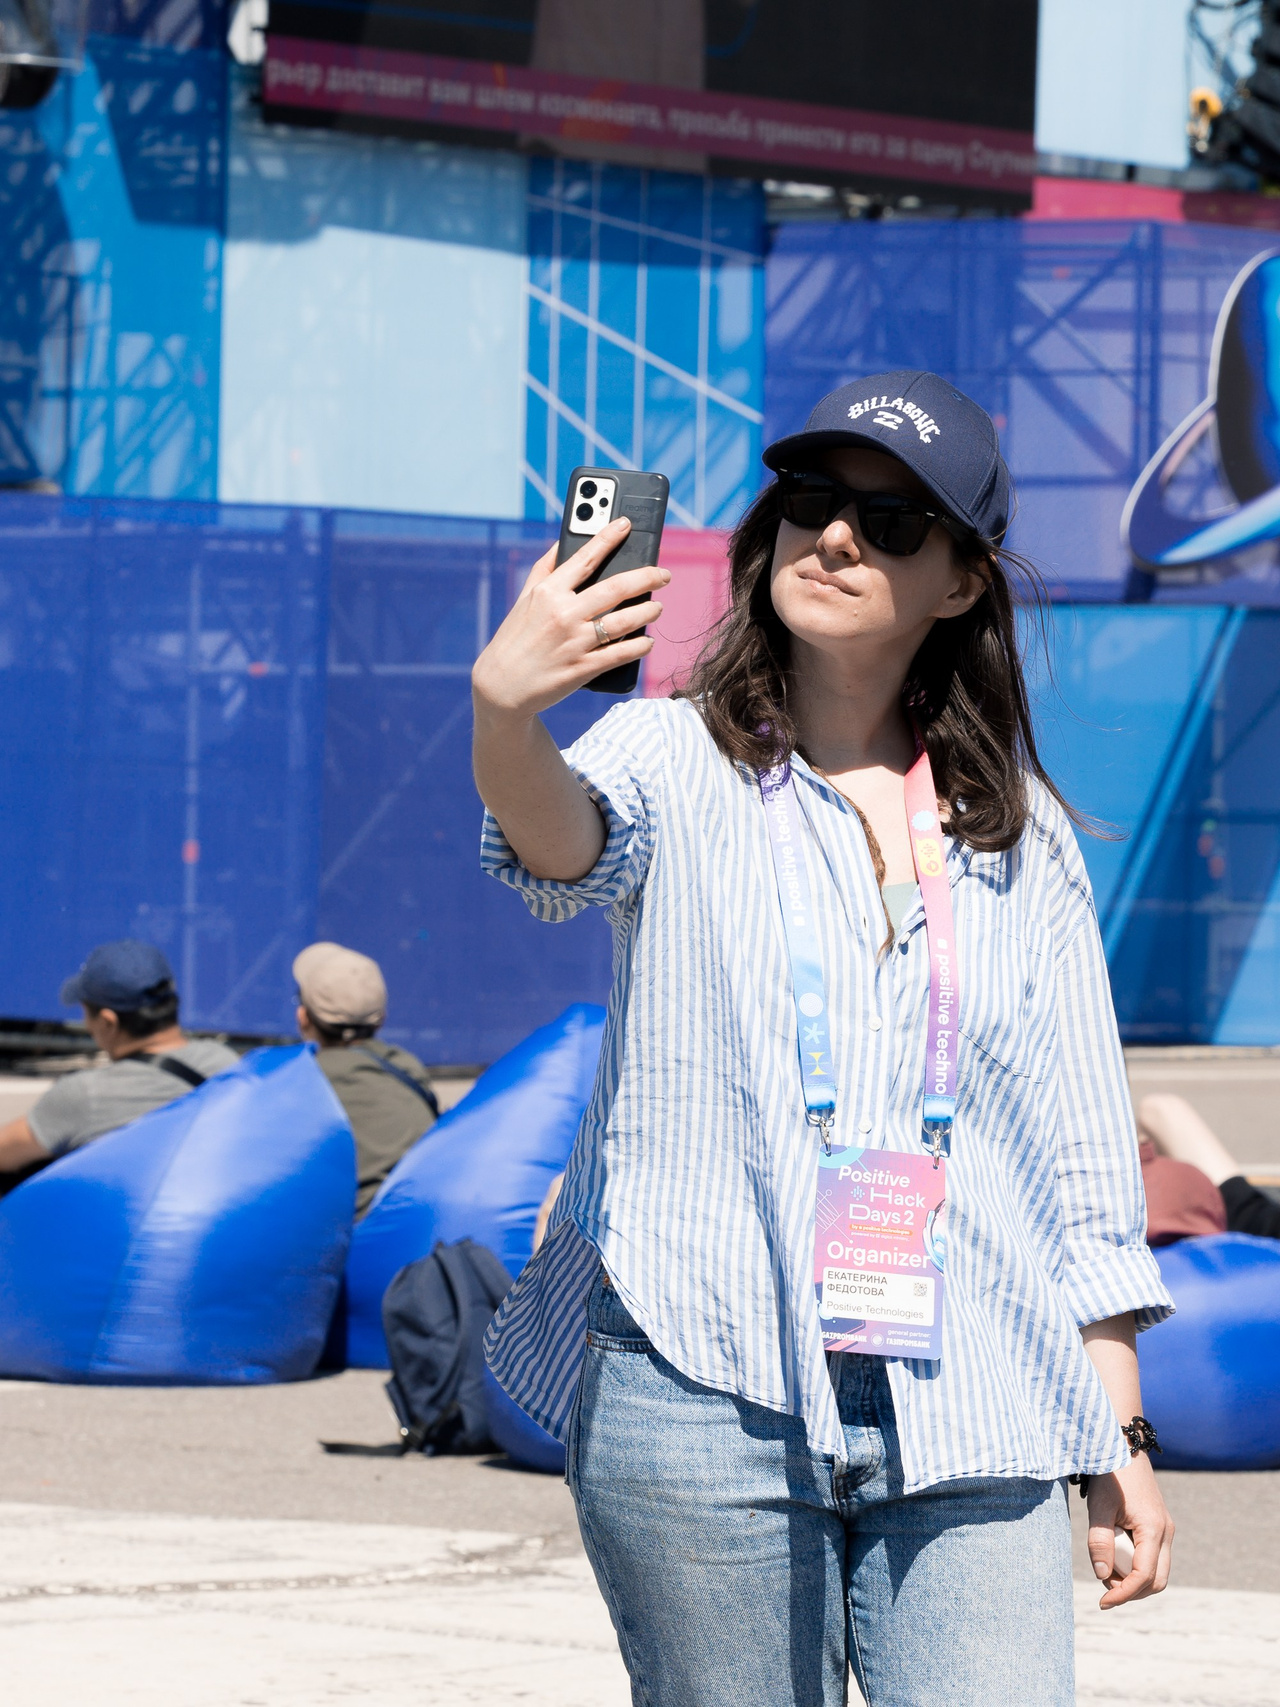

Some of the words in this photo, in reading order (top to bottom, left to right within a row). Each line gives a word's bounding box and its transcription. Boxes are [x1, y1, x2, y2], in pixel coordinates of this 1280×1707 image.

[847, 395, 941, 443] BILLABONG
[781, 845, 807, 910] positive
[935, 954, 954, 1025] positive
[934, 1029, 953, 1095] techno
[838, 1164, 910, 1188] Positive
[870, 1187, 926, 1208] Hack
[849, 1203, 901, 1226] Days
[903, 1209, 915, 1226] 2
[827, 1240, 931, 1269] Organizer
[827, 1270, 888, 1285] ЕКАТЕРИНА
[826, 1283, 885, 1297] ФЕДОТОВА
[826, 1300, 862, 1313] Positive
[865, 1304, 924, 1320] Technologies
